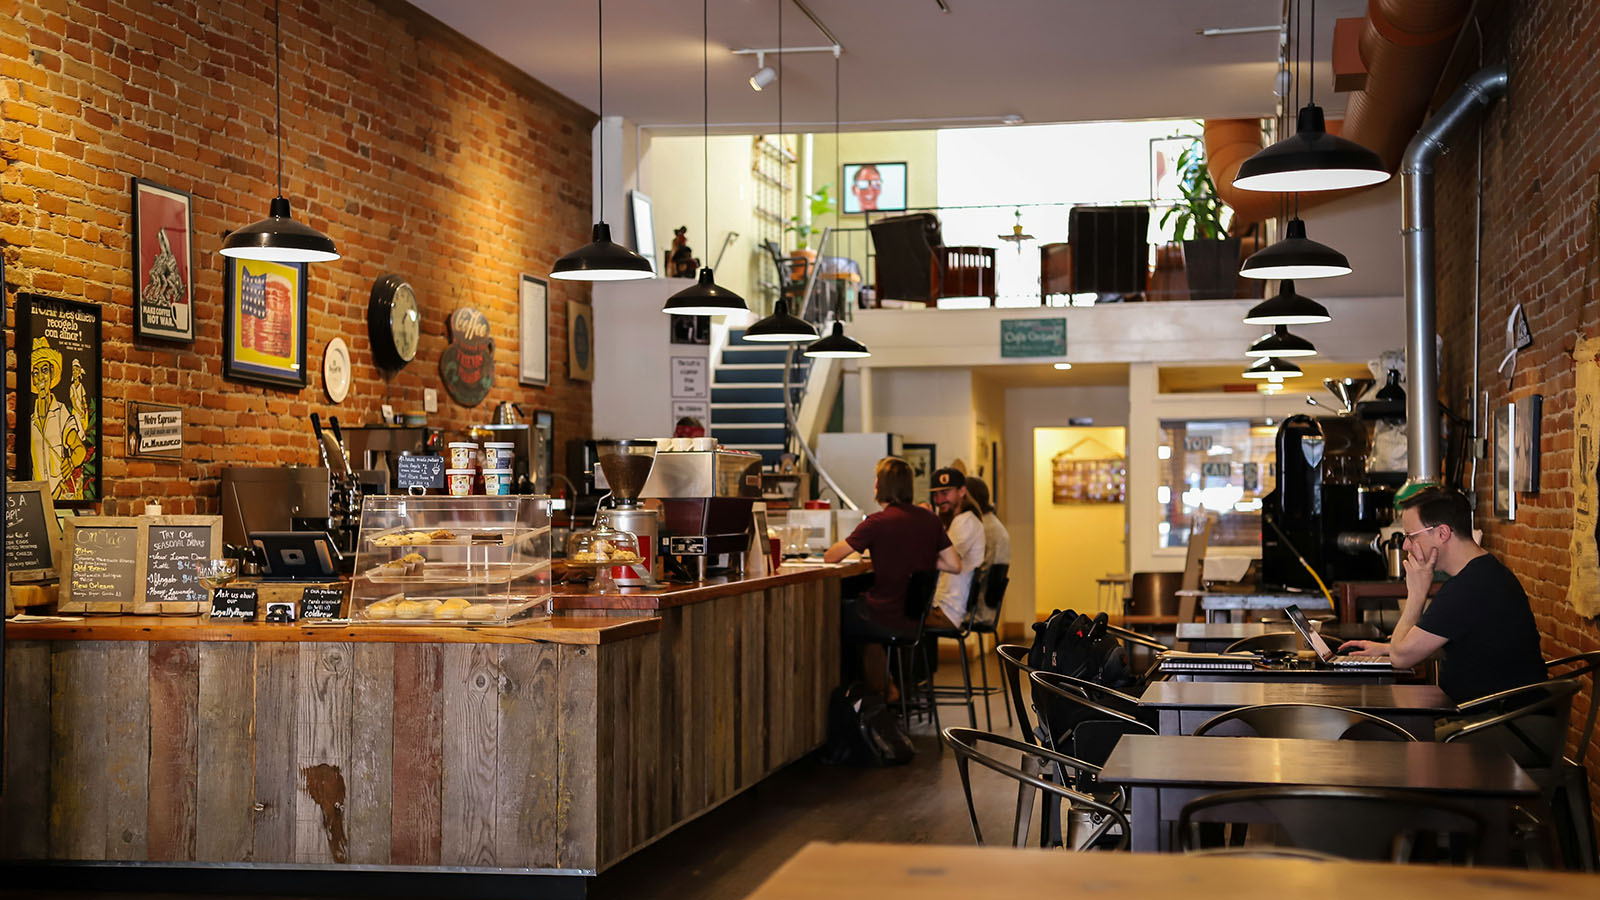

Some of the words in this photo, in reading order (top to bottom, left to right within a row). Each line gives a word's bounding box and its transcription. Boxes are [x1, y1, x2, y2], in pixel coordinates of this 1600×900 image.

[143, 305, 156, 315] MAKE
[156, 308, 171, 317] COFFEE
[147, 315, 159, 324] NOT
[455, 307, 488, 340] Coffee
[45, 329, 58, 338] con
[19, 494, 27, 506] A
[77, 530, 98, 543] On
[159, 530, 174, 539] TRY
[153, 540, 184, 551] SEASONAL
[215, 589, 229, 598] Ask
